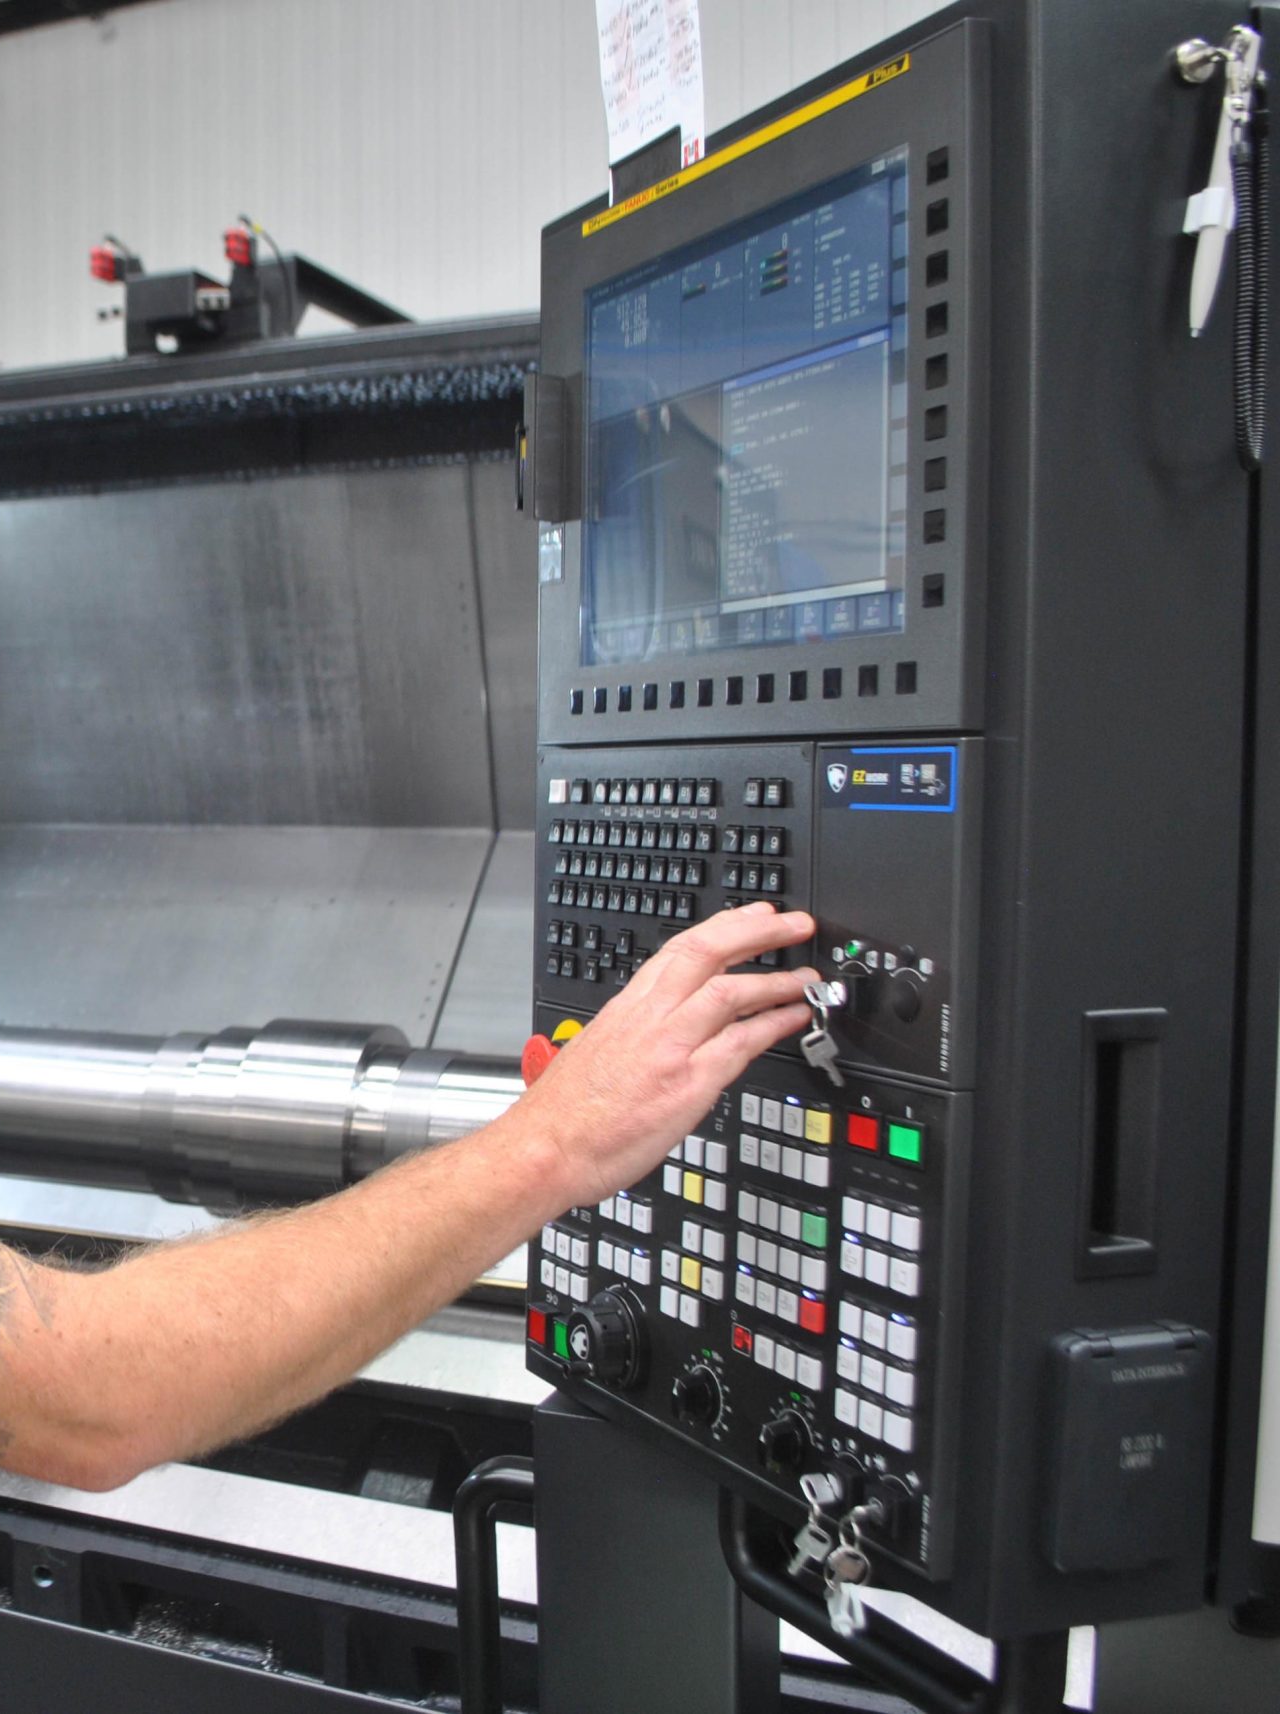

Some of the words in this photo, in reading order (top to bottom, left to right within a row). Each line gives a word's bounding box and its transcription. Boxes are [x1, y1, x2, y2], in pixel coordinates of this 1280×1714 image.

[655, 177, 679, 194] Series
[749, 835, 757, 848] 8
[771, 836, 778, 849] 9
[749, 871, 756, 883] 5
[770, 873, 777, 885] 6
